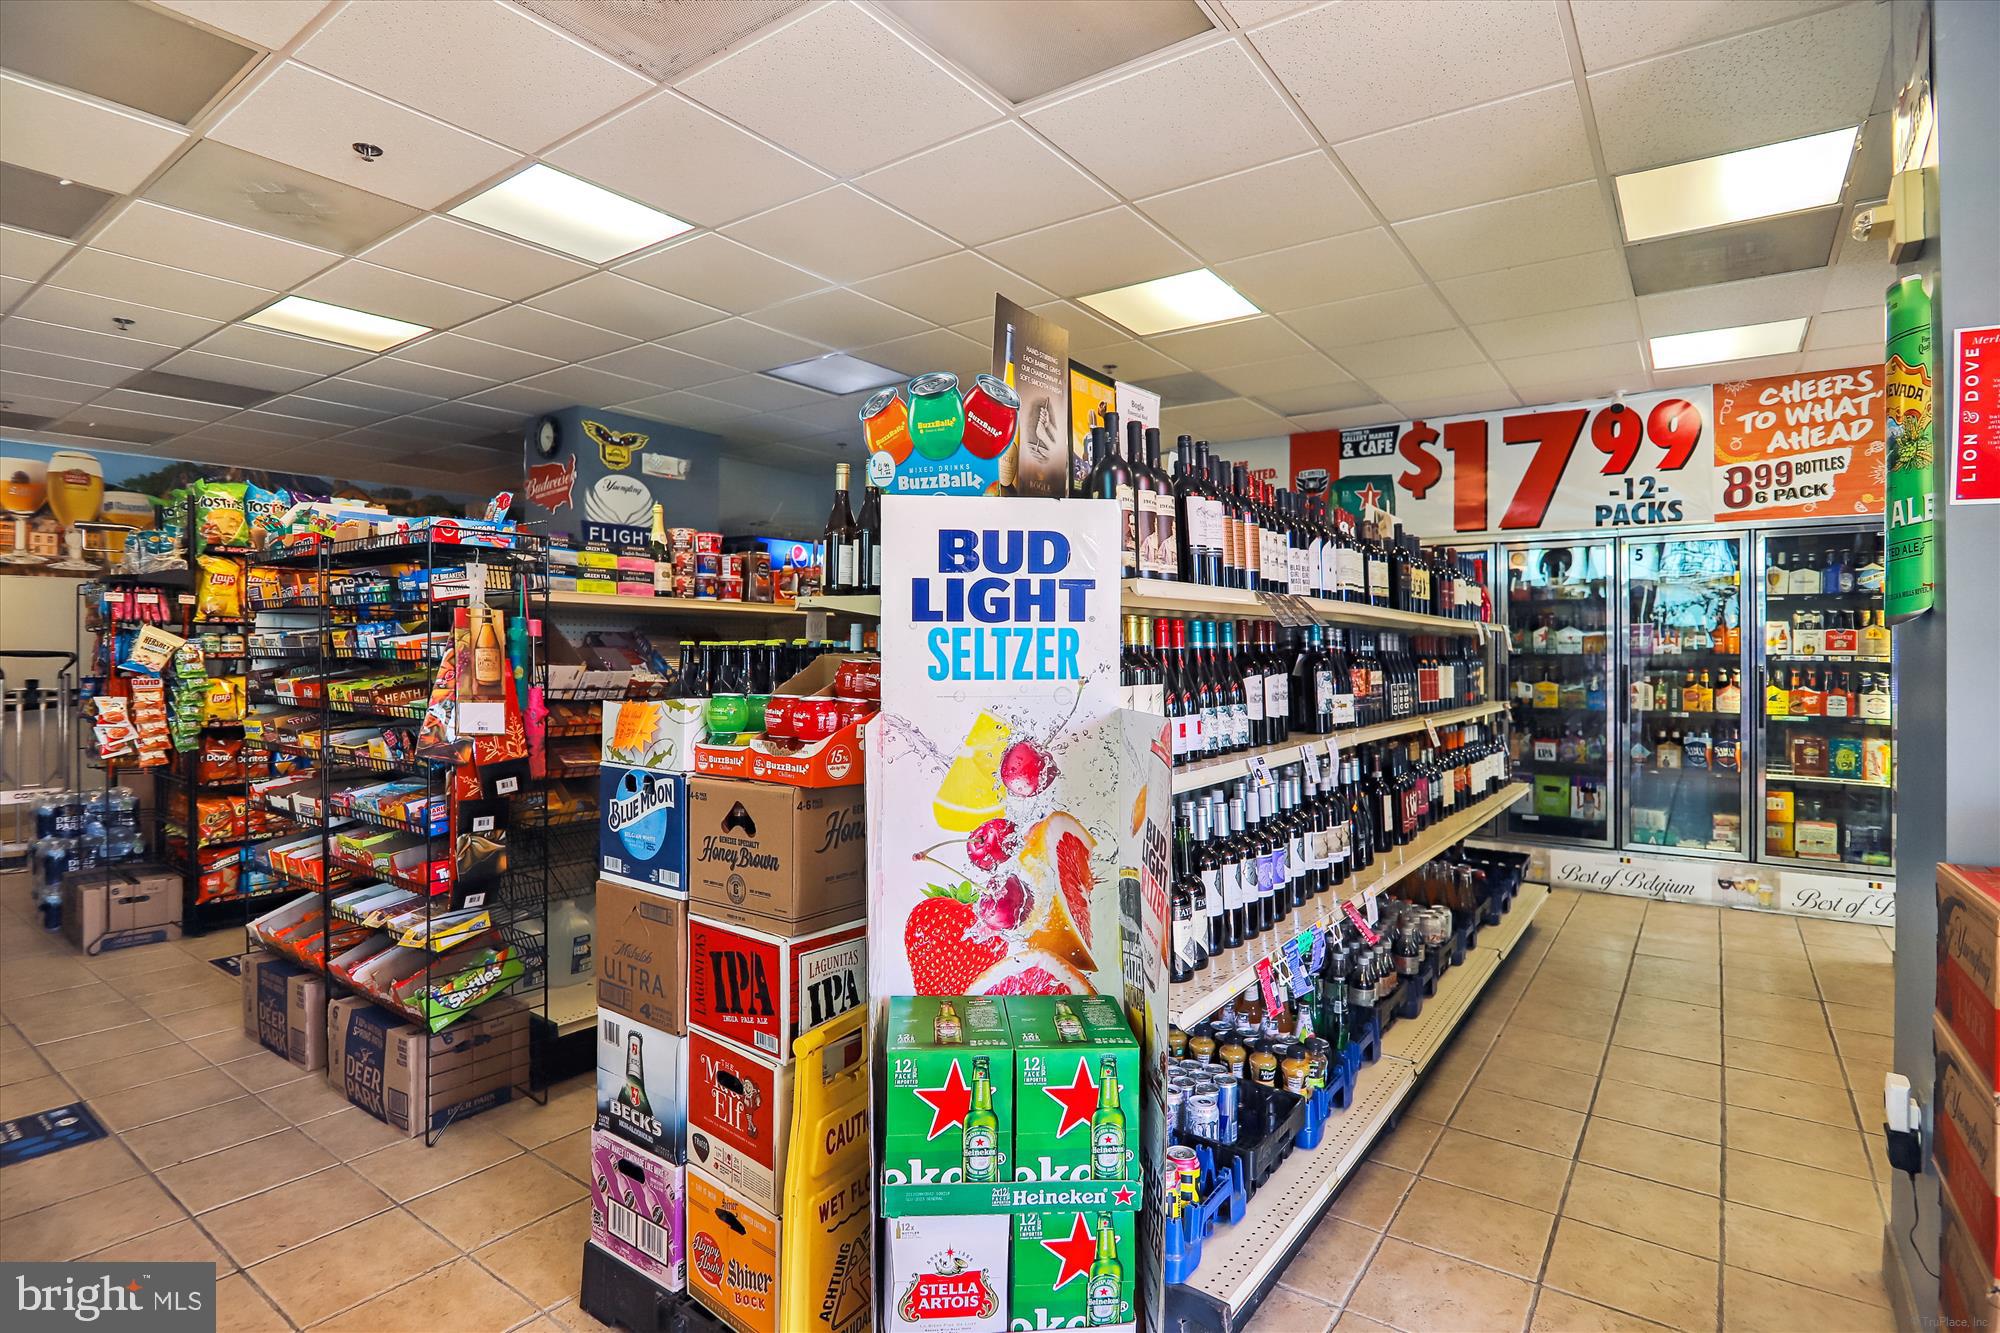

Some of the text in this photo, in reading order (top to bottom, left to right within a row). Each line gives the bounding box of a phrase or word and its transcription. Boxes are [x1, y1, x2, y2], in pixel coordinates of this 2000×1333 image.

[1758, 369, 1874, 407] CHEERS
[1736, 410, 1776, 434] TO
[1962, 348, 1980, 482] LION & DOVE
[1343, 439, 1393, 457] & CAFE
[1369, 432, 1393, 440] MARKET
[1767, 419, 1874, 454] AHEAD
[939, 464, 970, 472] DRINKS
[1795, 455, 1845, 477] BOTTLES
[603, 479, 643, 495] Yuengling
[1755, 482, 1828, 504] 6 PACK
[1595, 500, 1683, 527] PACKS
[938, 529, 1071, 574] BUD
[1635, 548, 1643, 561] 5
[912, 577, 1096, 623] LIGHT
[927, 627, 1080, 681] SELTZER
[384, 688, 421, 703] HEATH
[766, 761, 809, 775] BuzzBallz
[609, 798, 639, 830] BLUE
[797, 801, 811, 811] 4-6
[1146, 816, 1167, 862] BUD
[697, 835, 780, 872] Honey Brown
[1142, 839, 1168, 893] LIGHT
[1557, 863, 1696, 896] Best of Belgium
[1792, 888, 1873, 919] Best of
[612, 940, 653, 964] Michelob
[809, 950, 859, 979] LAGUNITAS
[448, 964, 503, 1009] Skittles
[604, 956, 665, 998] ULTRA
[694, 933, 707, 1016] LAGUNITAS
[709, 951, 775, 1016] IPA
[807, 969, 860, 1028] IPA
[259, 1002, 286, 1030] DEER
[723, 1015, 768, 1025] INDIA PALE ALE
[260, 1021, 287, 1053] PARK
[347, 1054, 381, 1093] DEER
[721, 1059, 734, 1071] THE
[895, 1059, 912, 1073] 12
[1024, 1057, 1040, 1070] 12
[347, 1078, 384, 1113] PARK
[609, 1099, 662, 1137] BECK'S
[712, 1088, 745, 1132] Elf
[963, 1148, 996, 1156] Heineken
[1092, 1146, 1124, 1154] Heineken
[818, 1190, 845, 1224] WET
[1013, 1189, 1107, 1206] Heineken
[901, 1223, 914, 1231] 12x
[1020, 1213, 1036, 1225] 12
[727, 1258, 773, 1294] Shiner
[819, 1243, 851, 1322] ACHTUNG
[920, 1282, 979, 1297] STELLA
[734, 1292, 766, 1311] BOCK
[918, 1295, 979, 1310] ARTOIS
[1088, 1297, 1119, 1306] Heineken
